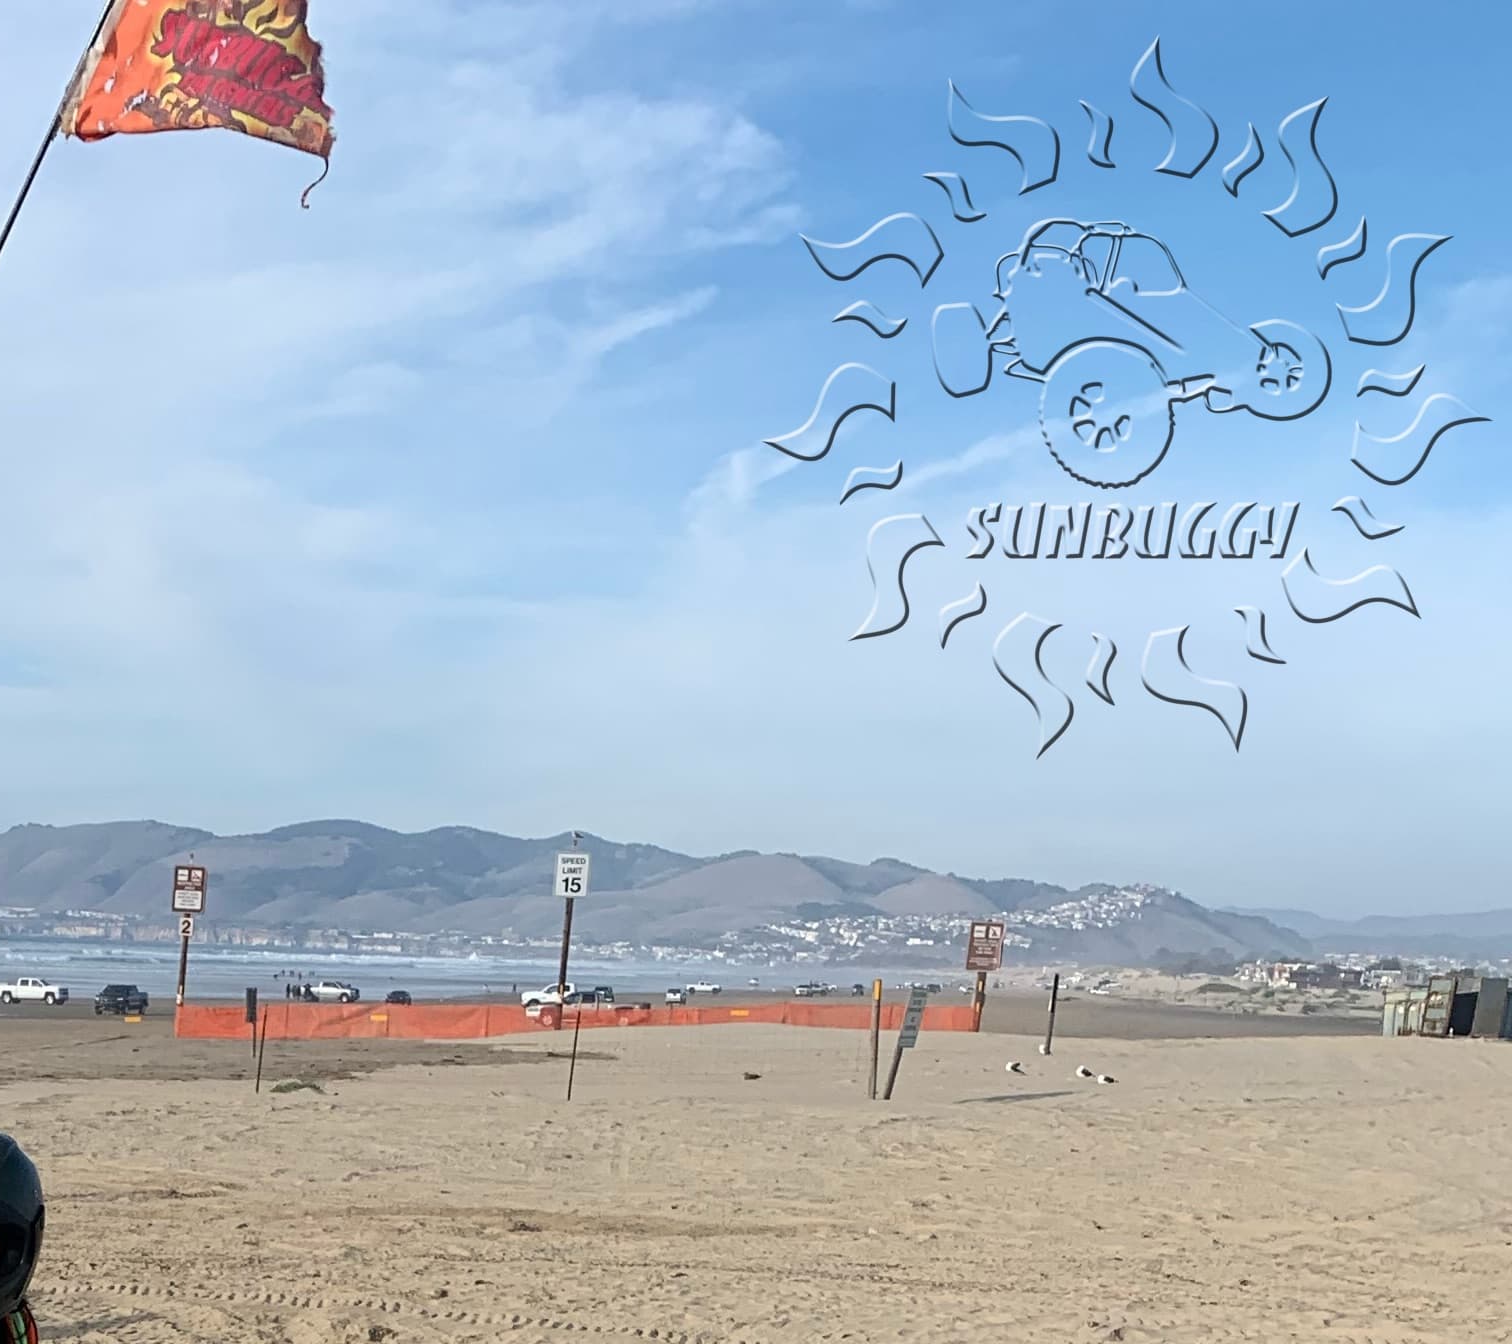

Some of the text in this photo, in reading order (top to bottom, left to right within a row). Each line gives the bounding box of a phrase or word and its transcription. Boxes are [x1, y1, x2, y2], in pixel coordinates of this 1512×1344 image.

[561, 857, 586, 865] SPEED
[561, 877, 581, 893] 15
[181, 919, 192, 934] 2
